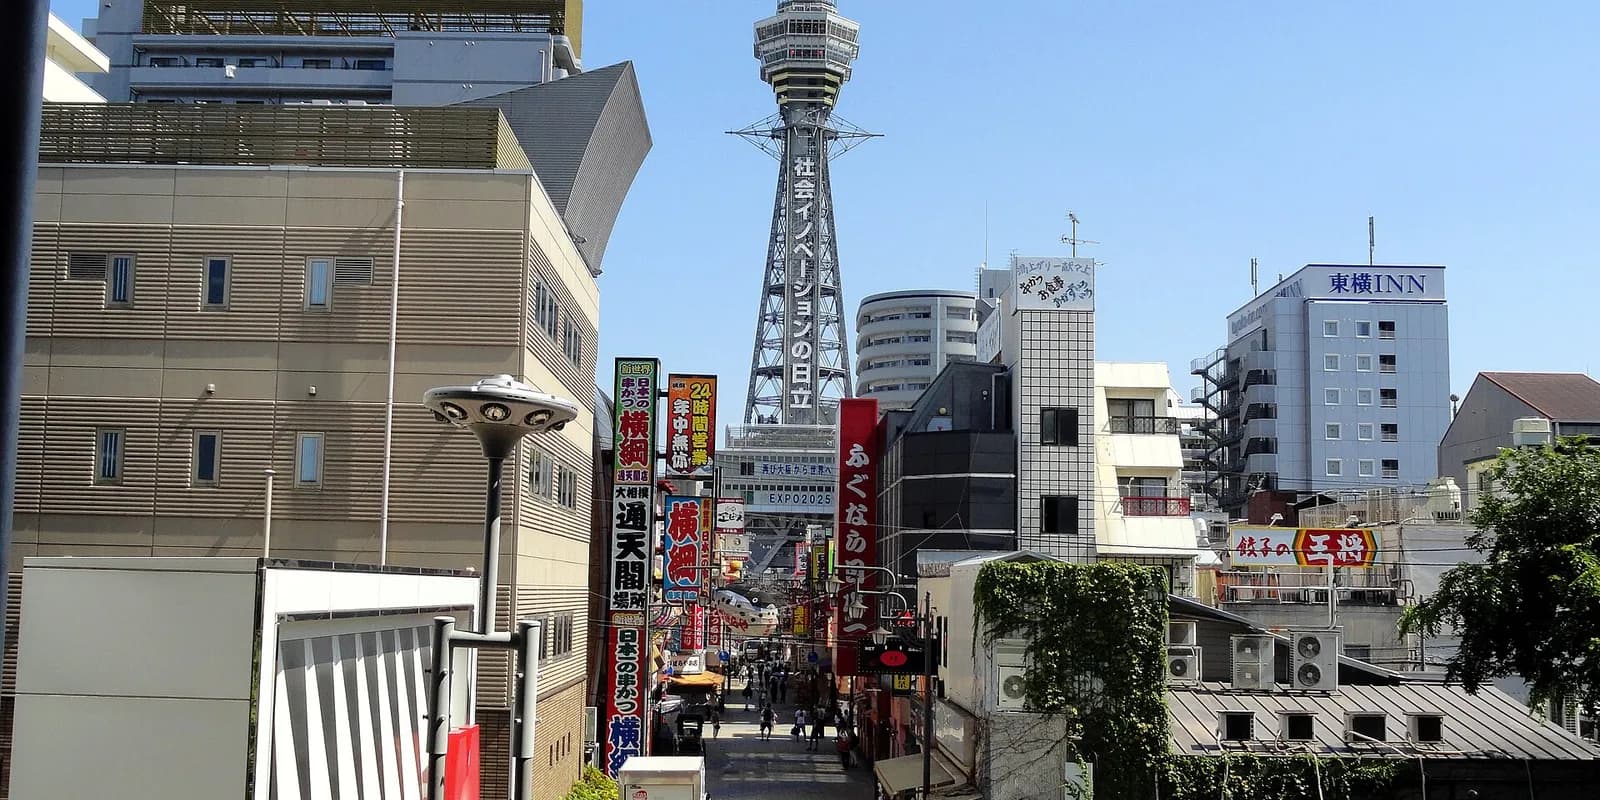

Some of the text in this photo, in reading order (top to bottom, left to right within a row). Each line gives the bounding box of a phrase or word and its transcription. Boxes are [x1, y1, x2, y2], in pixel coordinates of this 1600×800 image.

[790, 156, 816, 410] 社会イノベーションの日立
[1328, 272, 1427, 294] 東横INN
[620, 364, 651, 375] 新世界
[621, 377, 635, 408] 串かつ
[636, 378, 650, 408] 日本一の
[619, 410, 650, 467] 横綱
[672, 398, 690, 469] 年中無休
[690, 382, 712, 466] 24時間営業
[762, 464, 832, 475] 再び大阪から世界へ
[615, 487, 649, 499] 大相撲
[769, 493, 831, 504] EXPO2025
[616, 501, 648, 590] 通天閣
[667, 501, 699, 584] 横綱
[1237, 534, 1364, 562] 餃子の王将
[613, 591, 645, 609] 場所
[615, 629, 639, 713] 日本一の串かつ
